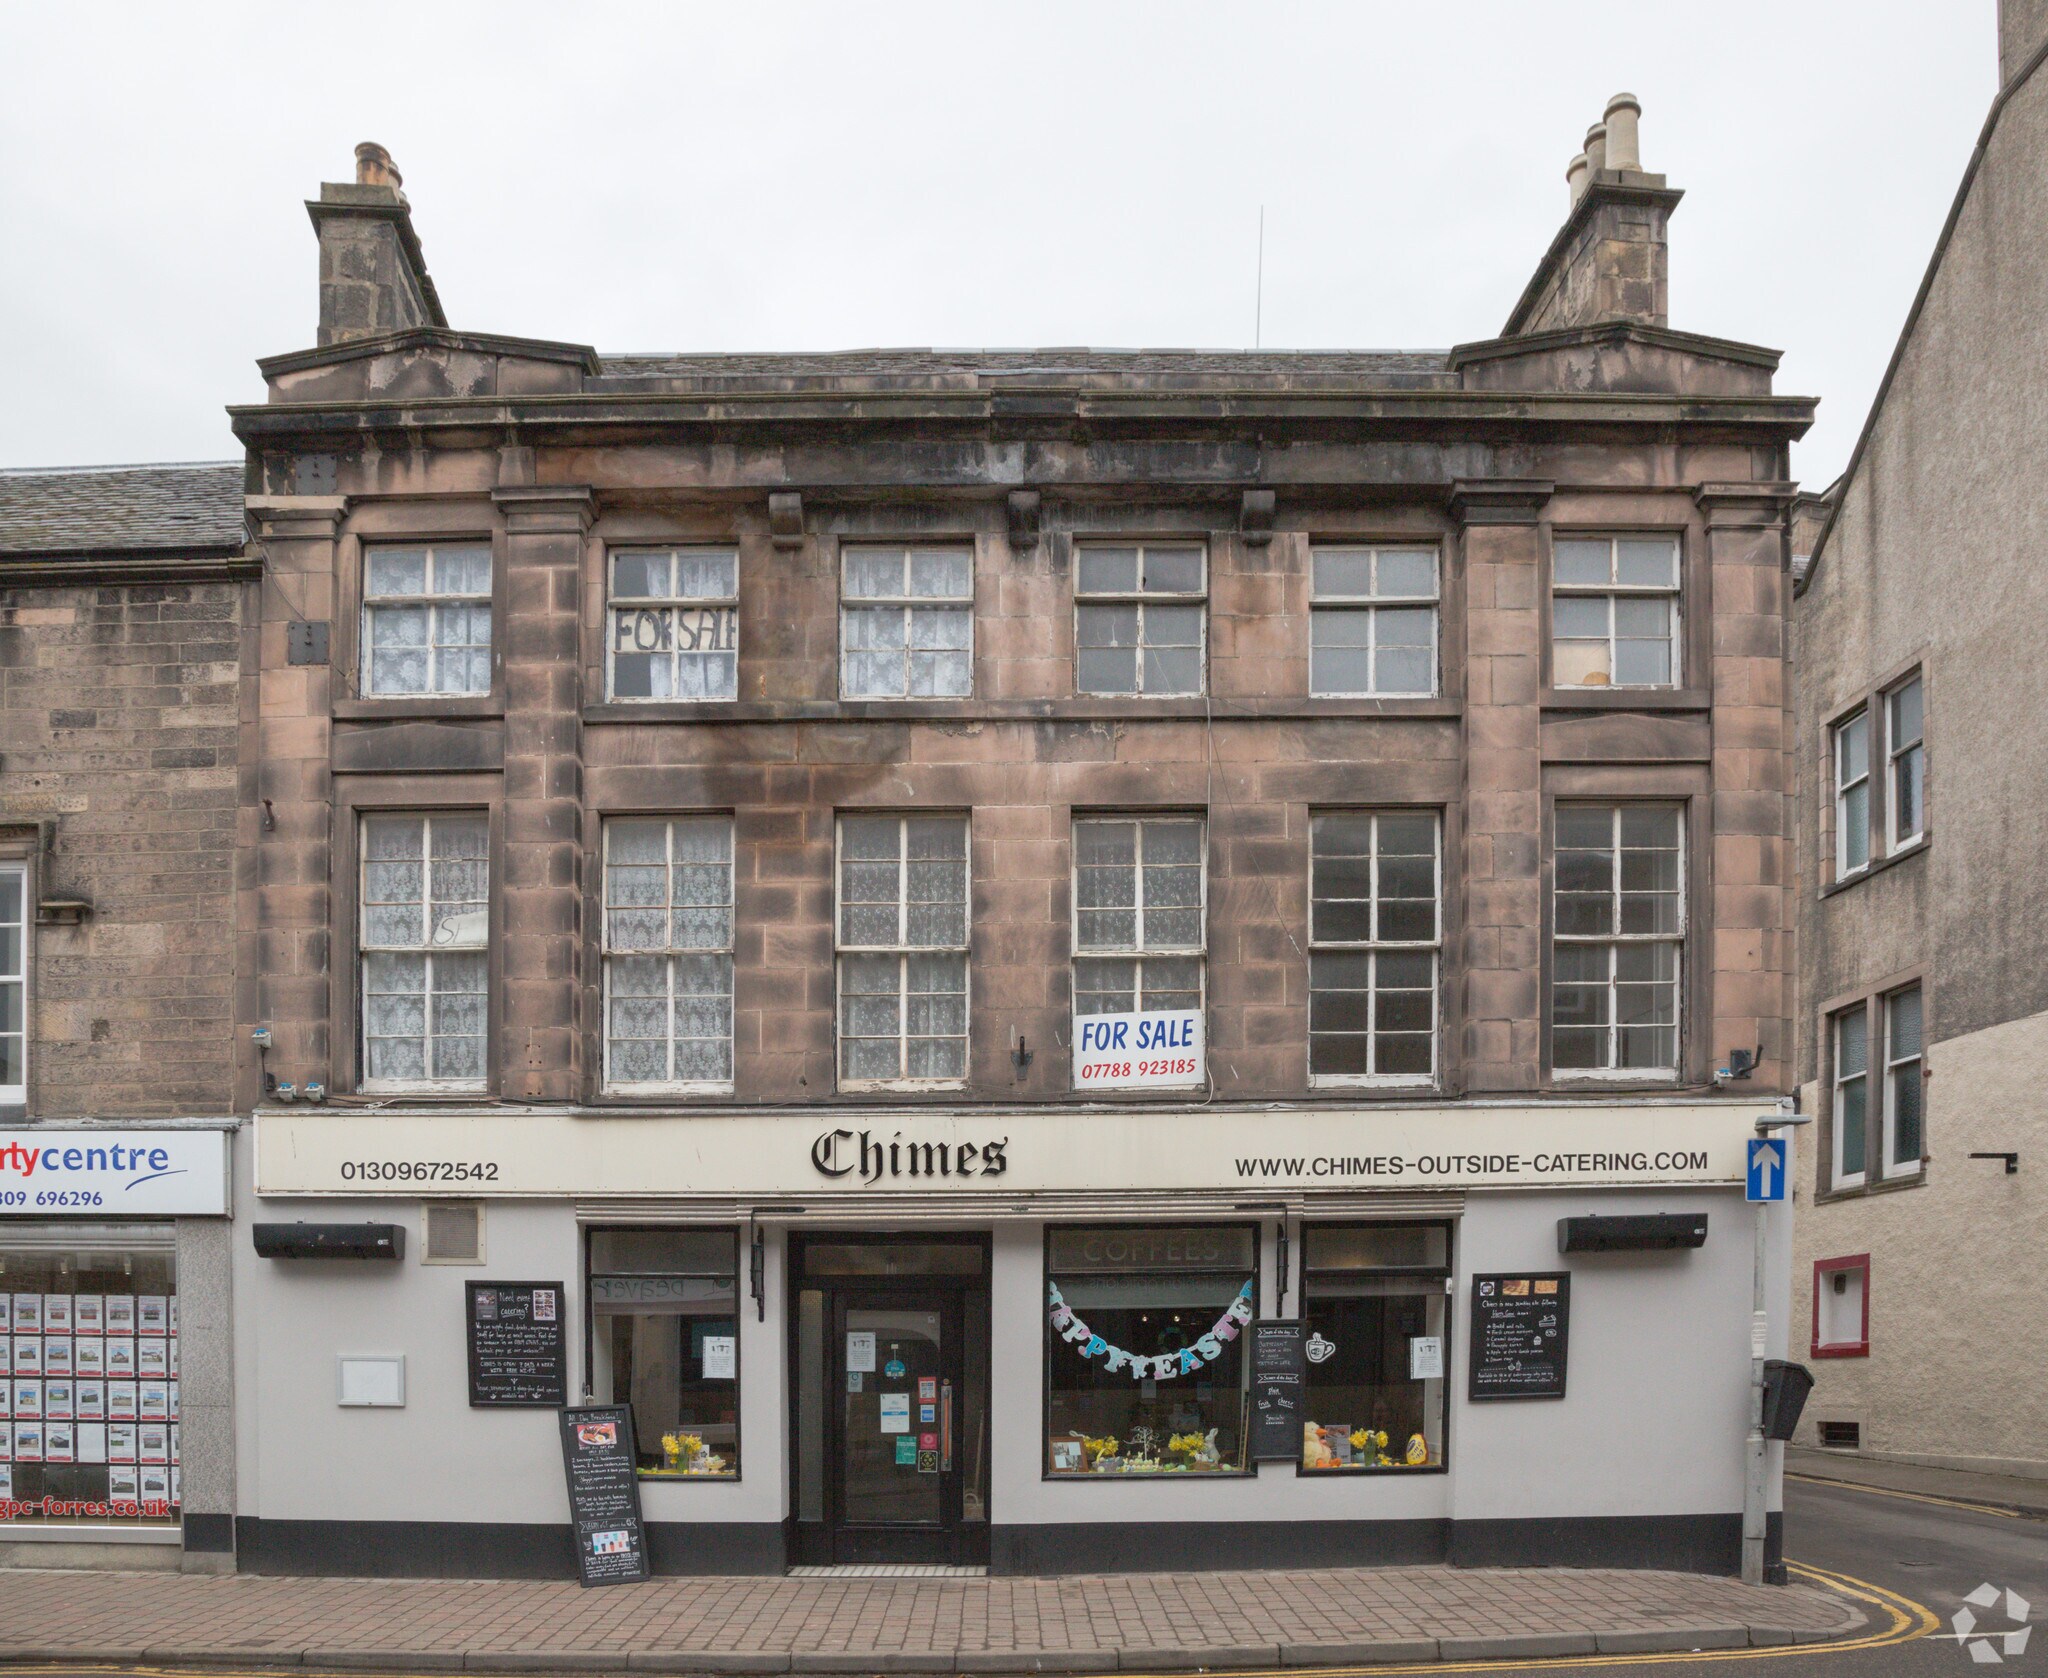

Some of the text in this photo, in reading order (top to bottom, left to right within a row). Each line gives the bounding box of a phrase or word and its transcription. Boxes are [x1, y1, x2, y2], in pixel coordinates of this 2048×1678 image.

[615, 607, 672, 650] FOR
[1082, 1019, 1194, 1051] FOR SALE
[1082, 1059, 1196, 1079] 07788 923185
[811, 1129, 1009, 1186] Chimes
[1235, 1151, 1708, 1177] WWW.CHIMES-OUTSIDE-CATERING.COM
[341, 1162, 499, 1180] 01309672542
[36, 1191, 103, 1206] 696296
